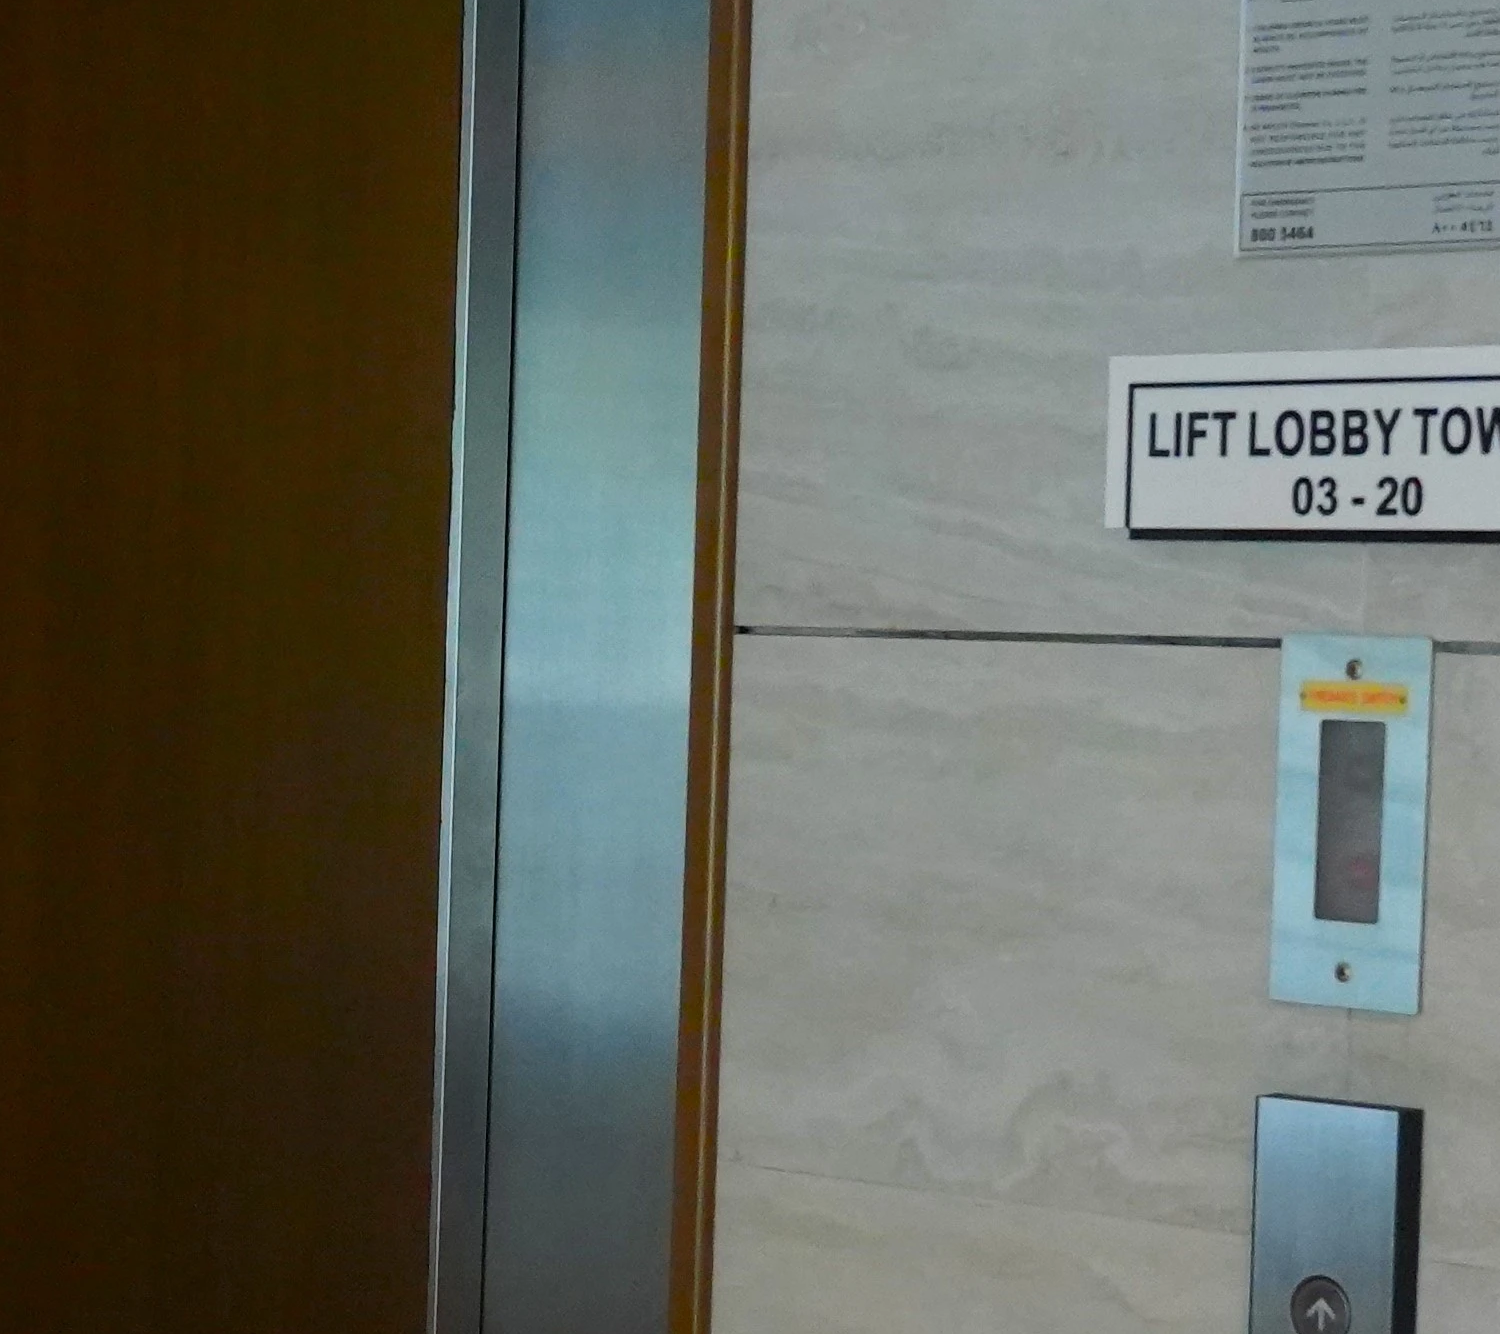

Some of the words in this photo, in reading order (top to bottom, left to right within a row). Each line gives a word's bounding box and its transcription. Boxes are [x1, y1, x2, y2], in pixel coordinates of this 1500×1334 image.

[1148, 412, 1236, 458] LIFT
[1248, 408, 1402, 457] LOBBY
[1292, 477, 1337, 516] 03
[1376, 476, 1424, 517] 20
